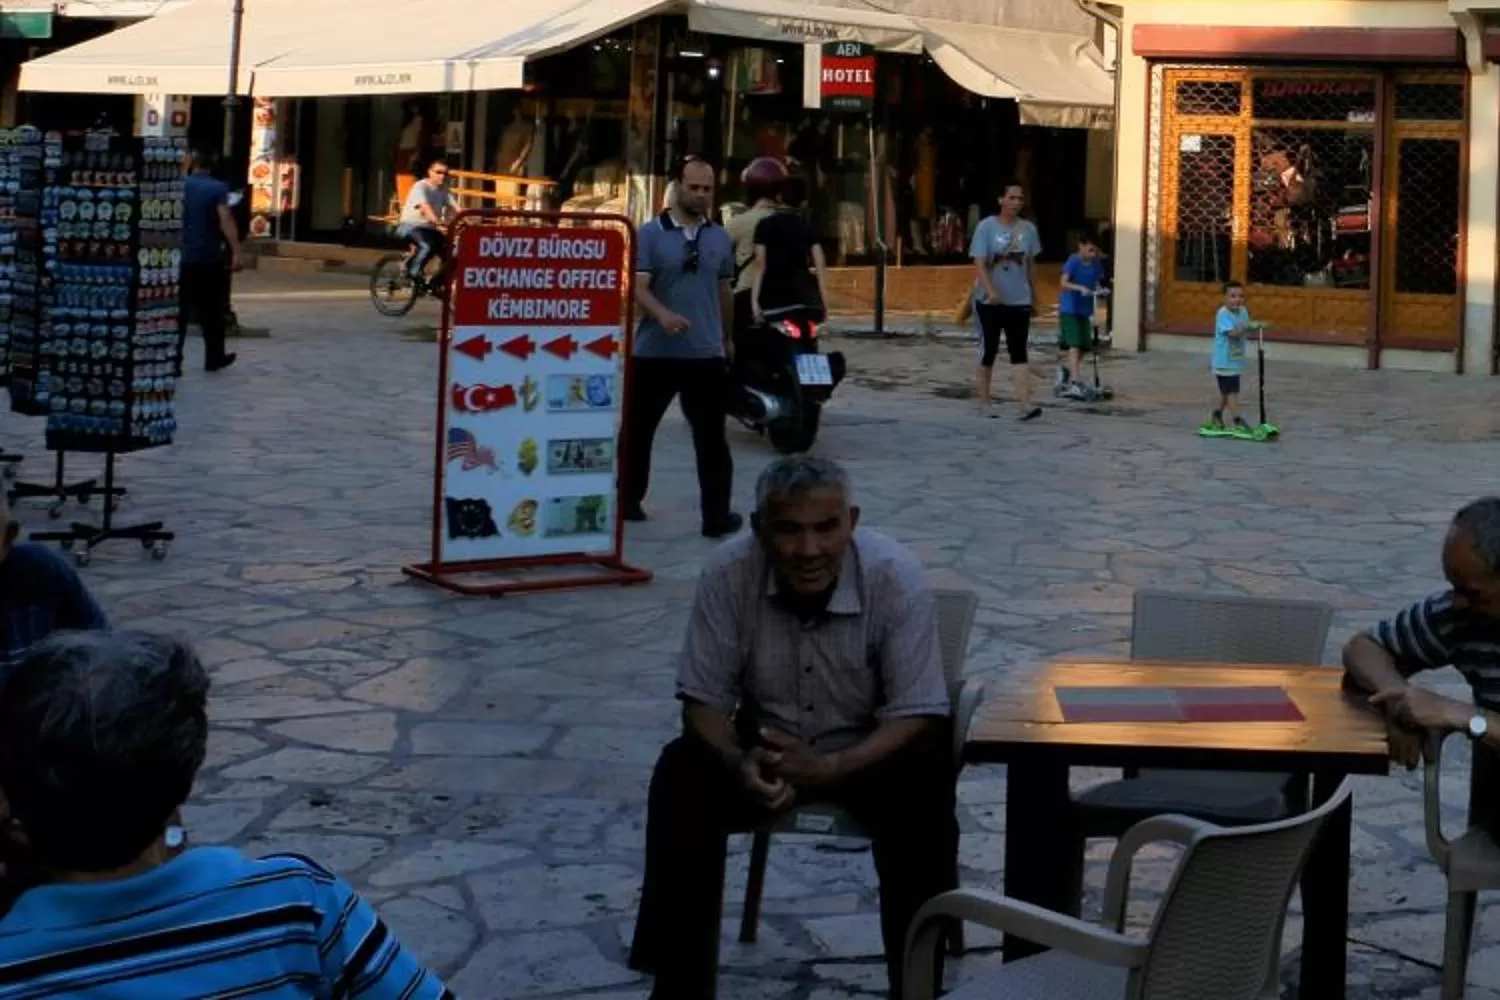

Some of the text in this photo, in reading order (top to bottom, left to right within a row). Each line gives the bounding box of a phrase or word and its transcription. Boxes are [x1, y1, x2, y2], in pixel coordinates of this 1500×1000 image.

[836, 43, 861, 56] AEN
[823, 69, 872, 83] HOTEL
[479, 232, 607, 259] DÖVIZ BÜROSU
[463, 267, 618, 290] EXCHANGE OFFICE
[487, 293, 591, 319] KËMBIMORE
